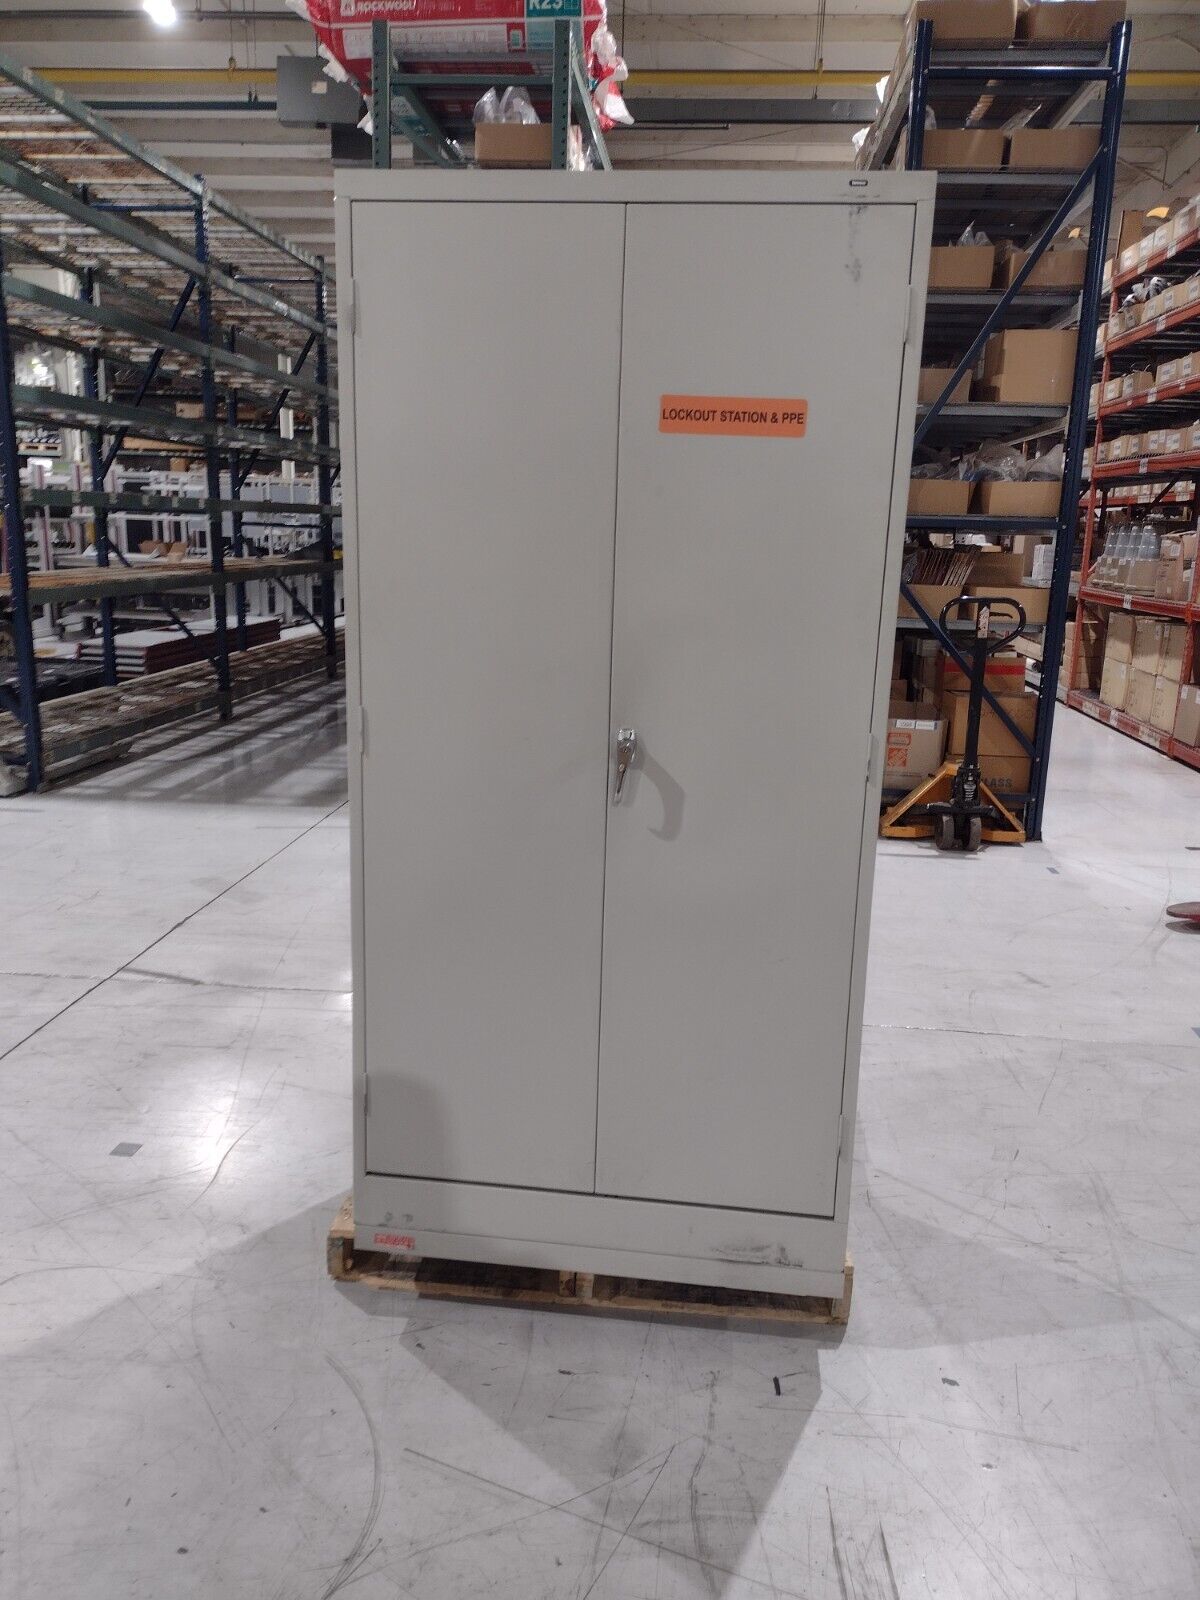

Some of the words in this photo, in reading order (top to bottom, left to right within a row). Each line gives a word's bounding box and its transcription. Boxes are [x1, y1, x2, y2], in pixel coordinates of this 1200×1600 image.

[662, 408, 717, 421] LOCKOUT
[720, 410, 767, 424] STATION
[770, 412, 779, 424] &
[782, 412, 804, 425] PPE
